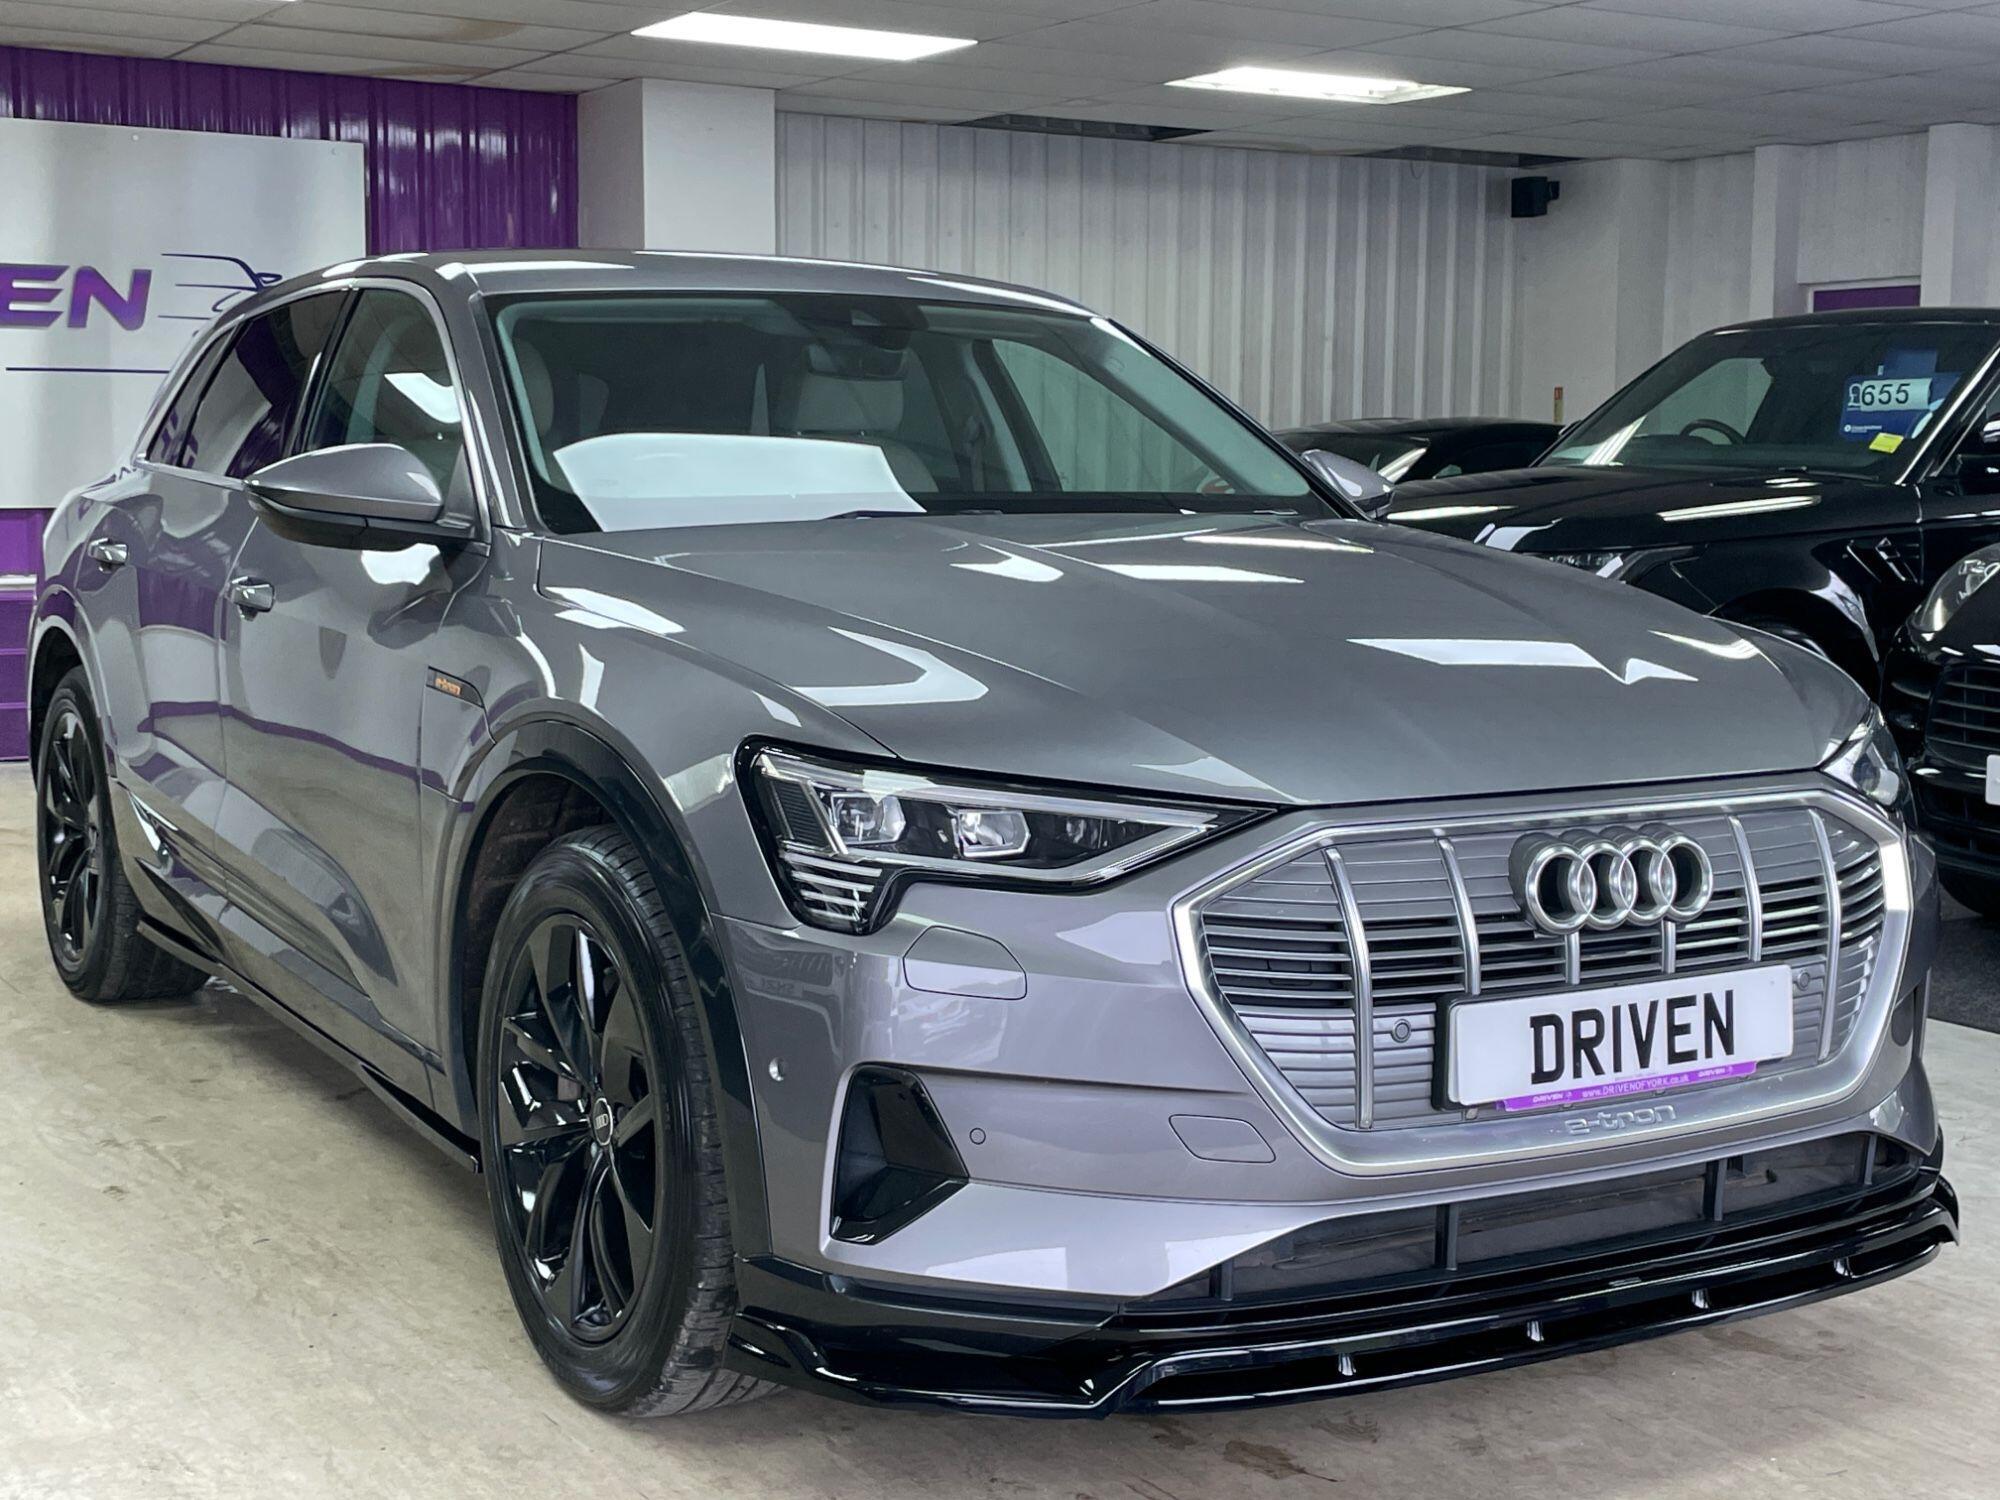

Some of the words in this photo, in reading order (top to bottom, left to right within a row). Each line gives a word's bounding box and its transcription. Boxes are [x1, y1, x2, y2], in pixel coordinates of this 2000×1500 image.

[1848, 383, 1911, 407] £655
[1530, 990, 1734, 1085] DRIVEN
[1565, 1105, 1676, 1134] e-tron
